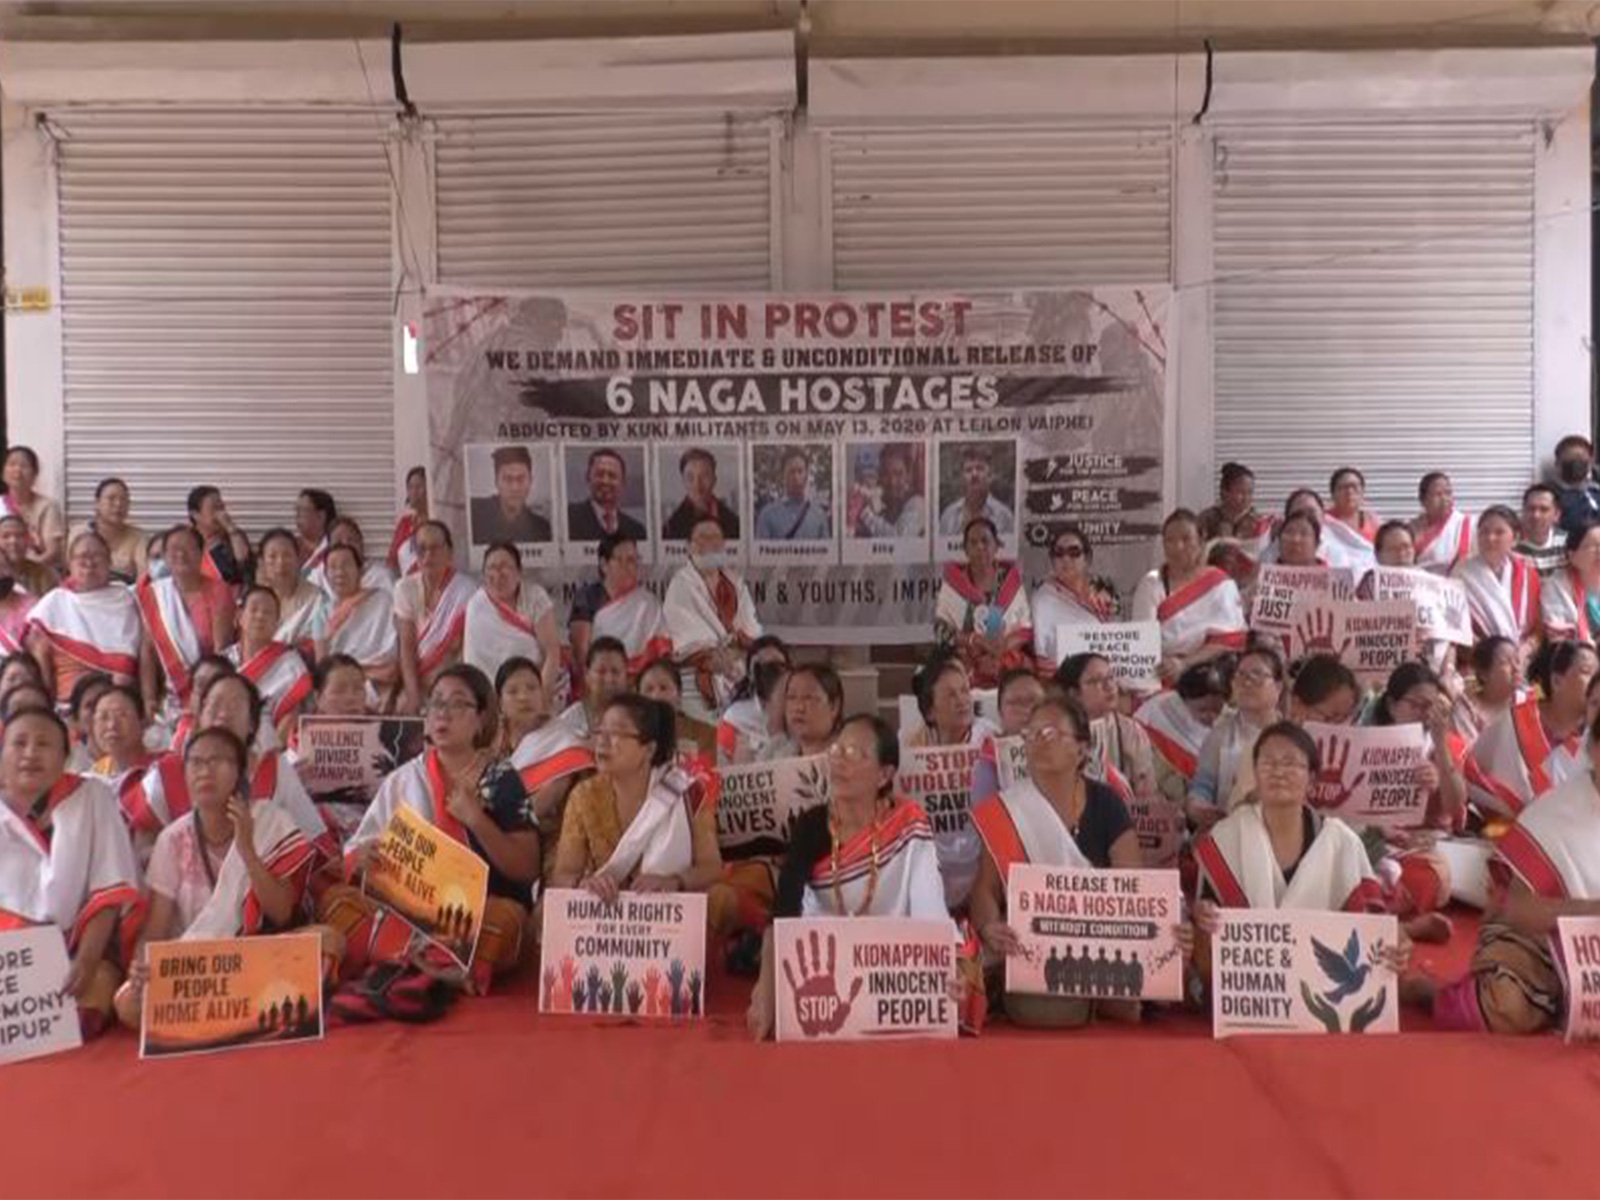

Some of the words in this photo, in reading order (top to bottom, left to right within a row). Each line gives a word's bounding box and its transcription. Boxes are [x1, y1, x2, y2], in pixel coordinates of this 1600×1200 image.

[612, 303, 683, 341] SIT
[699, 304, 749, 340] IN
[764, 302, 973, 340] PROTEST
[485, 350, 521, 371] WE
[526, 350, 621, 370] DEMAND
[627, 349, 756, 369] IMMEDIATE
[762, 348, 776, 368] &
[782, 346, 960, 369] UNCONDITIONAL
[966, 345, 1067, 366] RELEASE
[1072, 344, 1099, 365] OF
[605, 375, 634, 414] 6
[648, 378, 767, 414] NAGA
[780, 375, 1000, 413] HOSTAGES
[496, 421, 592, 439] ABDUCTED
[598, 422, 621, 439] BY
[627, 421, 669, 439] KUKI
[675, 420, 770, 438] MILITANTS
[775, 420, 801, 436] ON
[807, 419, 846, 436] MAY
[933, 416, 954, 434] AT
[1068, 453, 1123, 468] JUSTICE
[1072, 489, 1119, 503] PEACE
[1078, 521, 1120, 535] UNITY
[776, 582, 788, 604] &
[798, 580, 883, 606] YOUTHS,
[892, 577, 943, 602] IMPH
[1263, 569, 1330, 591] KIDNAPPING
[1258, 598, 1293, 620] JUST
[1344, 614, 1412, 632] KIDNAPPING
[1088, 642, 1131, 652] PEACE
[1354, 634, 1410, 648] INNOCENT
[1359, 649, 1409, 666] PEOPLE
[310, 729, 364, 747] VIOLENCE
[314, 748, 360, 764] DIVIDES
[721, 769, 774, 792] OTECT
[899, 769, 972, 794] VIOLEN
[1367, 767, 1415, 786] INNOCE
[924, 792, 971, 813] SAV
[1369, 787, 1422, 808] PEOPLE
[386, 836, 426, 875] PEOPLE
[404, 871, 437, 905] ALIVE
[1045, 873, 1109, 893] RELEASE
[1113, 877, 1140, 893] THE
[566, 899, 624, 921] HUMAN
[628, 902, 684, 923] RIGHTS
[1019, 891, 1030, 911] 6
[1034, 891, 1078, 916] NAGA
[1083, 896, 1168, 919] HOSTAGES
[595, 923, 616, 935] FOR
[620, 924, 652, 935] EVERY
[1039, 919, 1086, 935] WITHOUT
[1090, 922, 1149, 937] CONDITION
[1219, 922, 1297, 946] JUSTICE,
[574, 935, 671, 958] COMMUNITY
[853, 943, 951, 968] KIDNAPPING
[1220, 946, 1276, 968] PEACE
[1280, 948, 1292, 968] &
[1572, 933, 1600, 967] HO
[0, 947, 34, 971] RE
[159, 955, 207, 978] BRING
[212, 953, 243, 974] OUR
[173, 977, 230, 999] PEOPLE
[868, 971, 949, 995] INNOCENT
[1220, 970, 1286, 995] HUMAN
[1581, 970, 1600, 995] AR
[0, 989, 66, 1020] MONY
[152, 1001, 201, 1026] HOME
[205, 997, 251, 1021] ALIVE
[799, 994, 838, 1022] STOP
[877, 998, 948, 1026] PEOPLE
[1221, 994, 1293, 1019] DIGNITY
[1581, 999, 1600, 1021] NO
[0, 1014, 61, 1046] IPUR"
